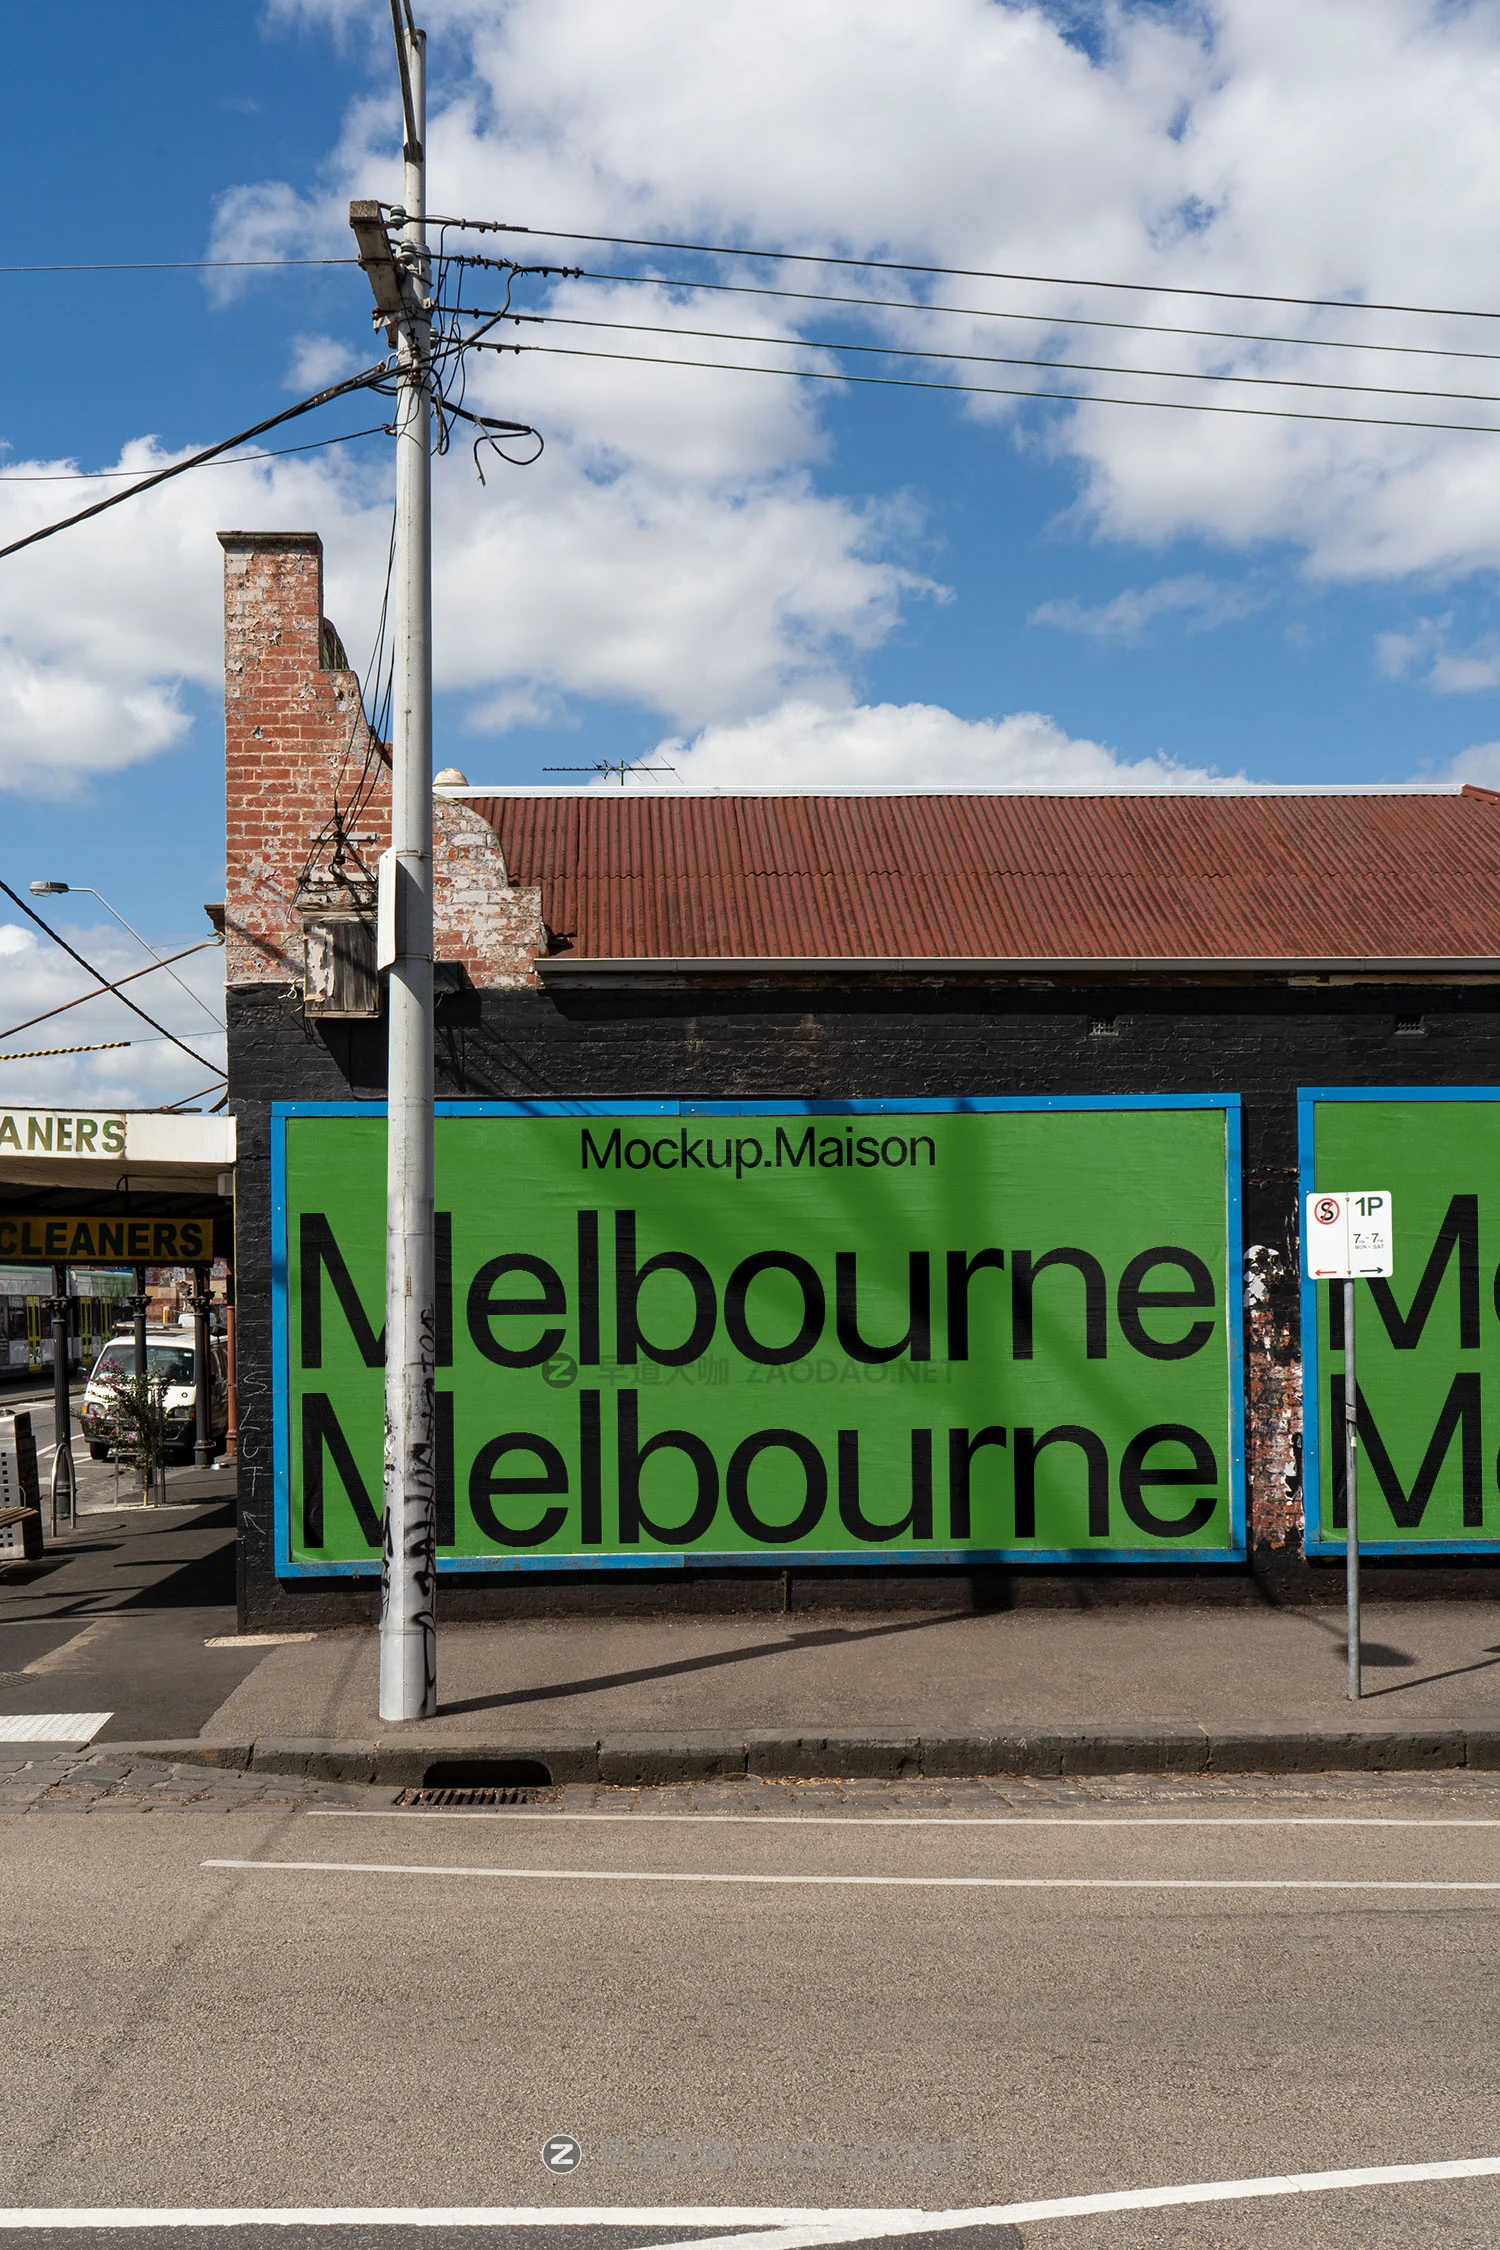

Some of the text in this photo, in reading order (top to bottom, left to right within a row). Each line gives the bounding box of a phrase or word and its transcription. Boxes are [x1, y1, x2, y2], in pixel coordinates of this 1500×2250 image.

[0, 1115, 126, 1153] ANERS
[581, 1126, 936, 1180] Mockup.Maison
[0, 1221, 204, 1257] CLEANERS
[1355, 1196, 1384, 1217] 1P
[299, 1209, 1216, 1370] Melbourne
[1327, 1193, 1500, 1350] M
[301, 1388, 1218, 1549] Melbourne
[1330, 1372, 1500, 1529] M
